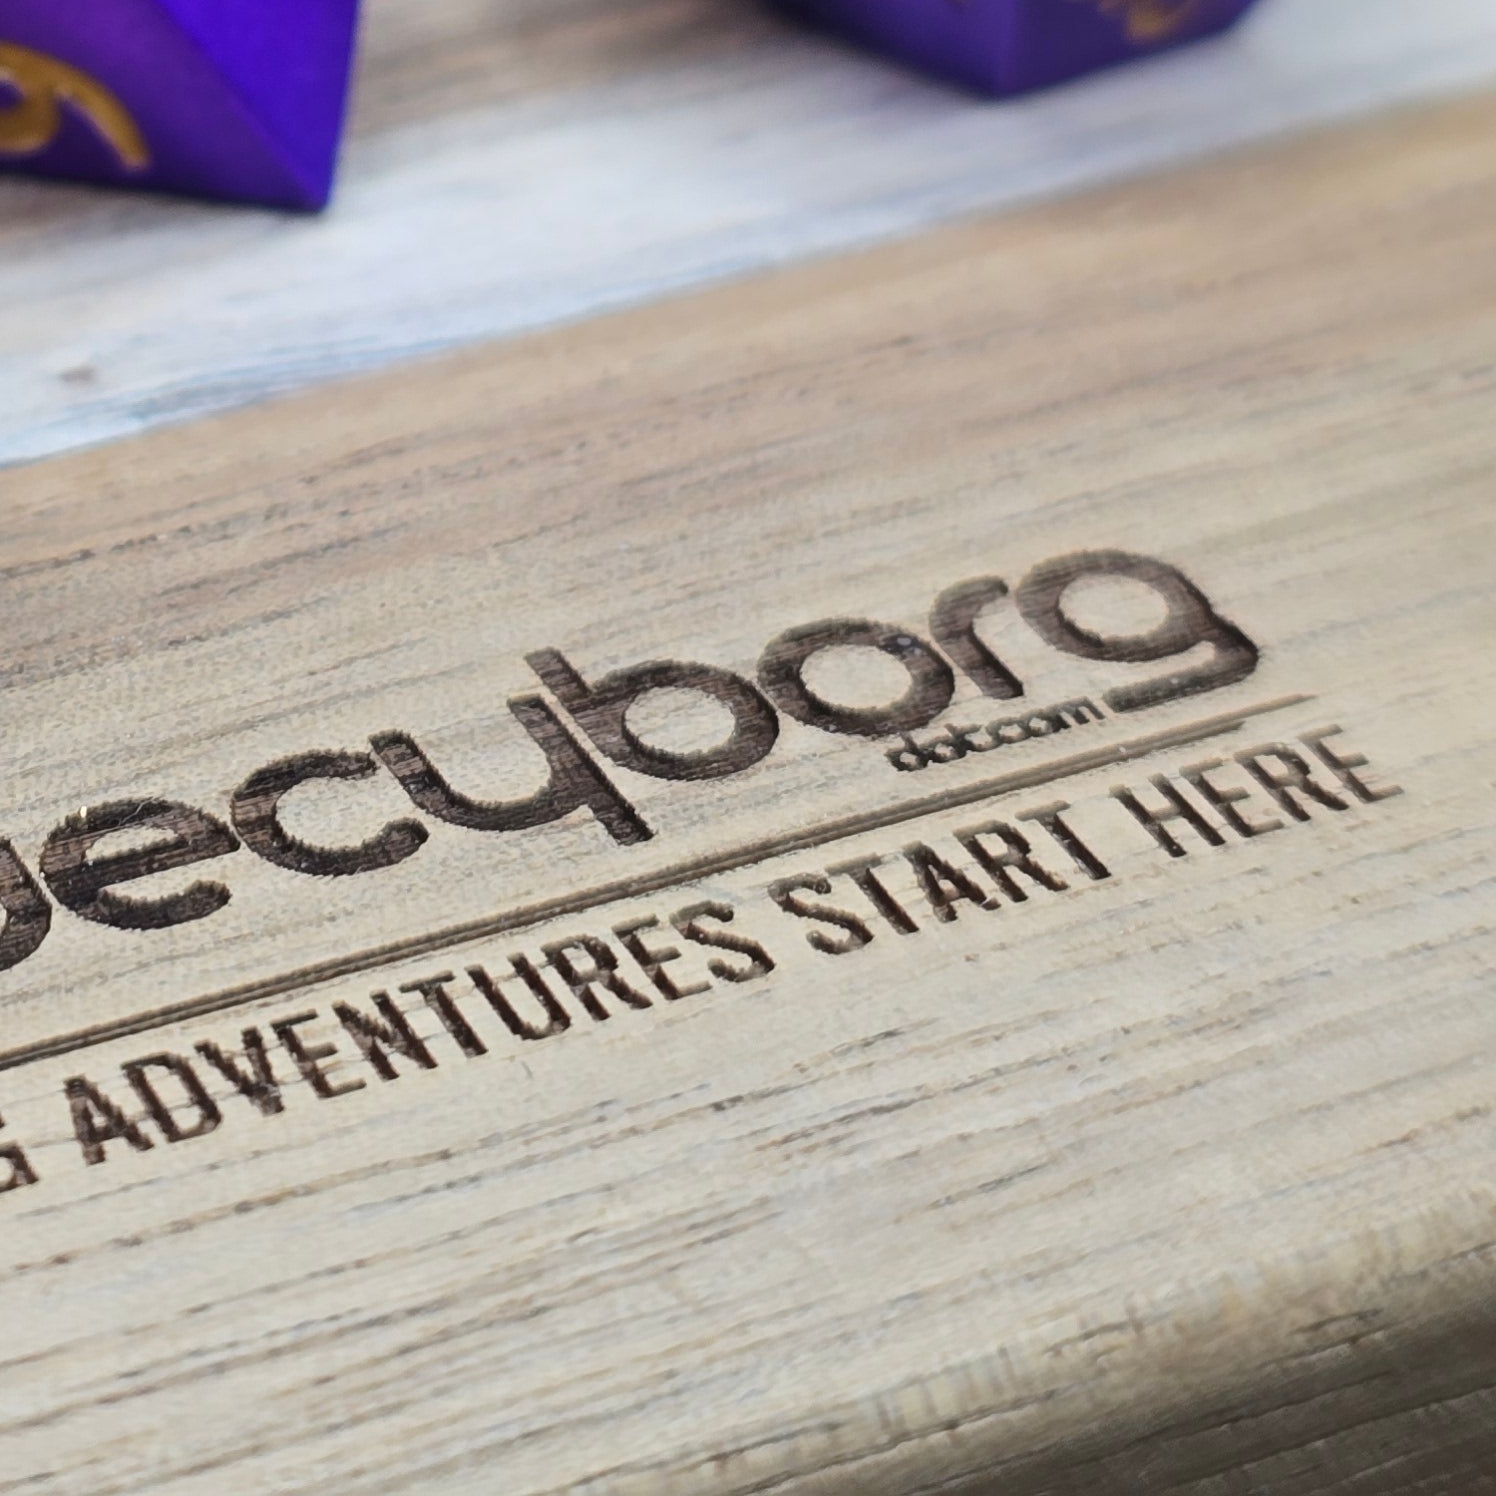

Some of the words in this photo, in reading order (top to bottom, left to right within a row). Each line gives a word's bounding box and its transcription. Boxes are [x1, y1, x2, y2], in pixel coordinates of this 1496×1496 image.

[884, 695, 1106, 773] dotcom
[62, 901, 776, 1166] ADVENTURES
[768, 800, 1112, 956] START
[1110, 723, 1404, 858] HERE
